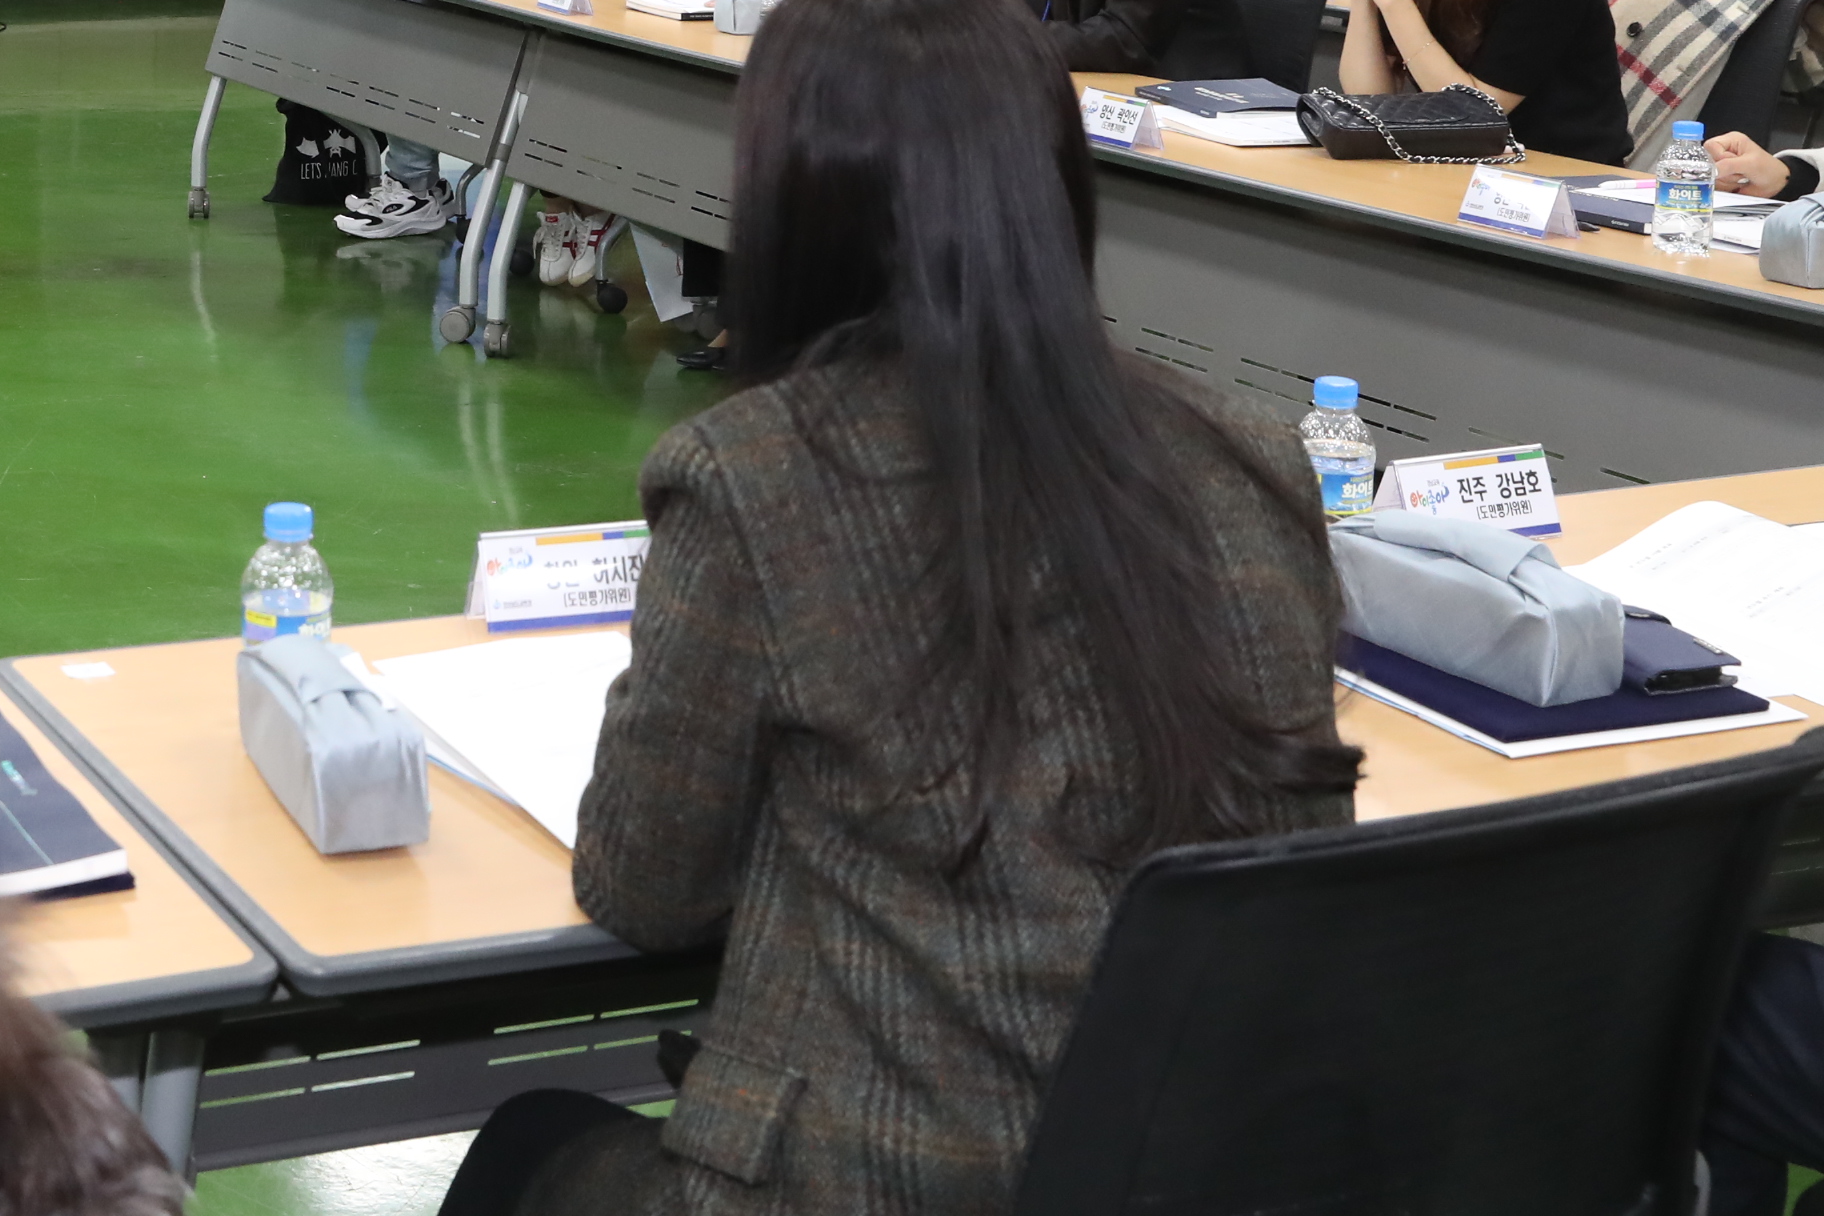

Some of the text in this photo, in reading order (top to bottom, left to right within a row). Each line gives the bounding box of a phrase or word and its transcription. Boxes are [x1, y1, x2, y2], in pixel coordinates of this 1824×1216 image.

[324, 160, 349, 179] ANG
[1668, 188, 1702, 201] 화이트
[1457, 469, 1542, 504] 진주 강남호
